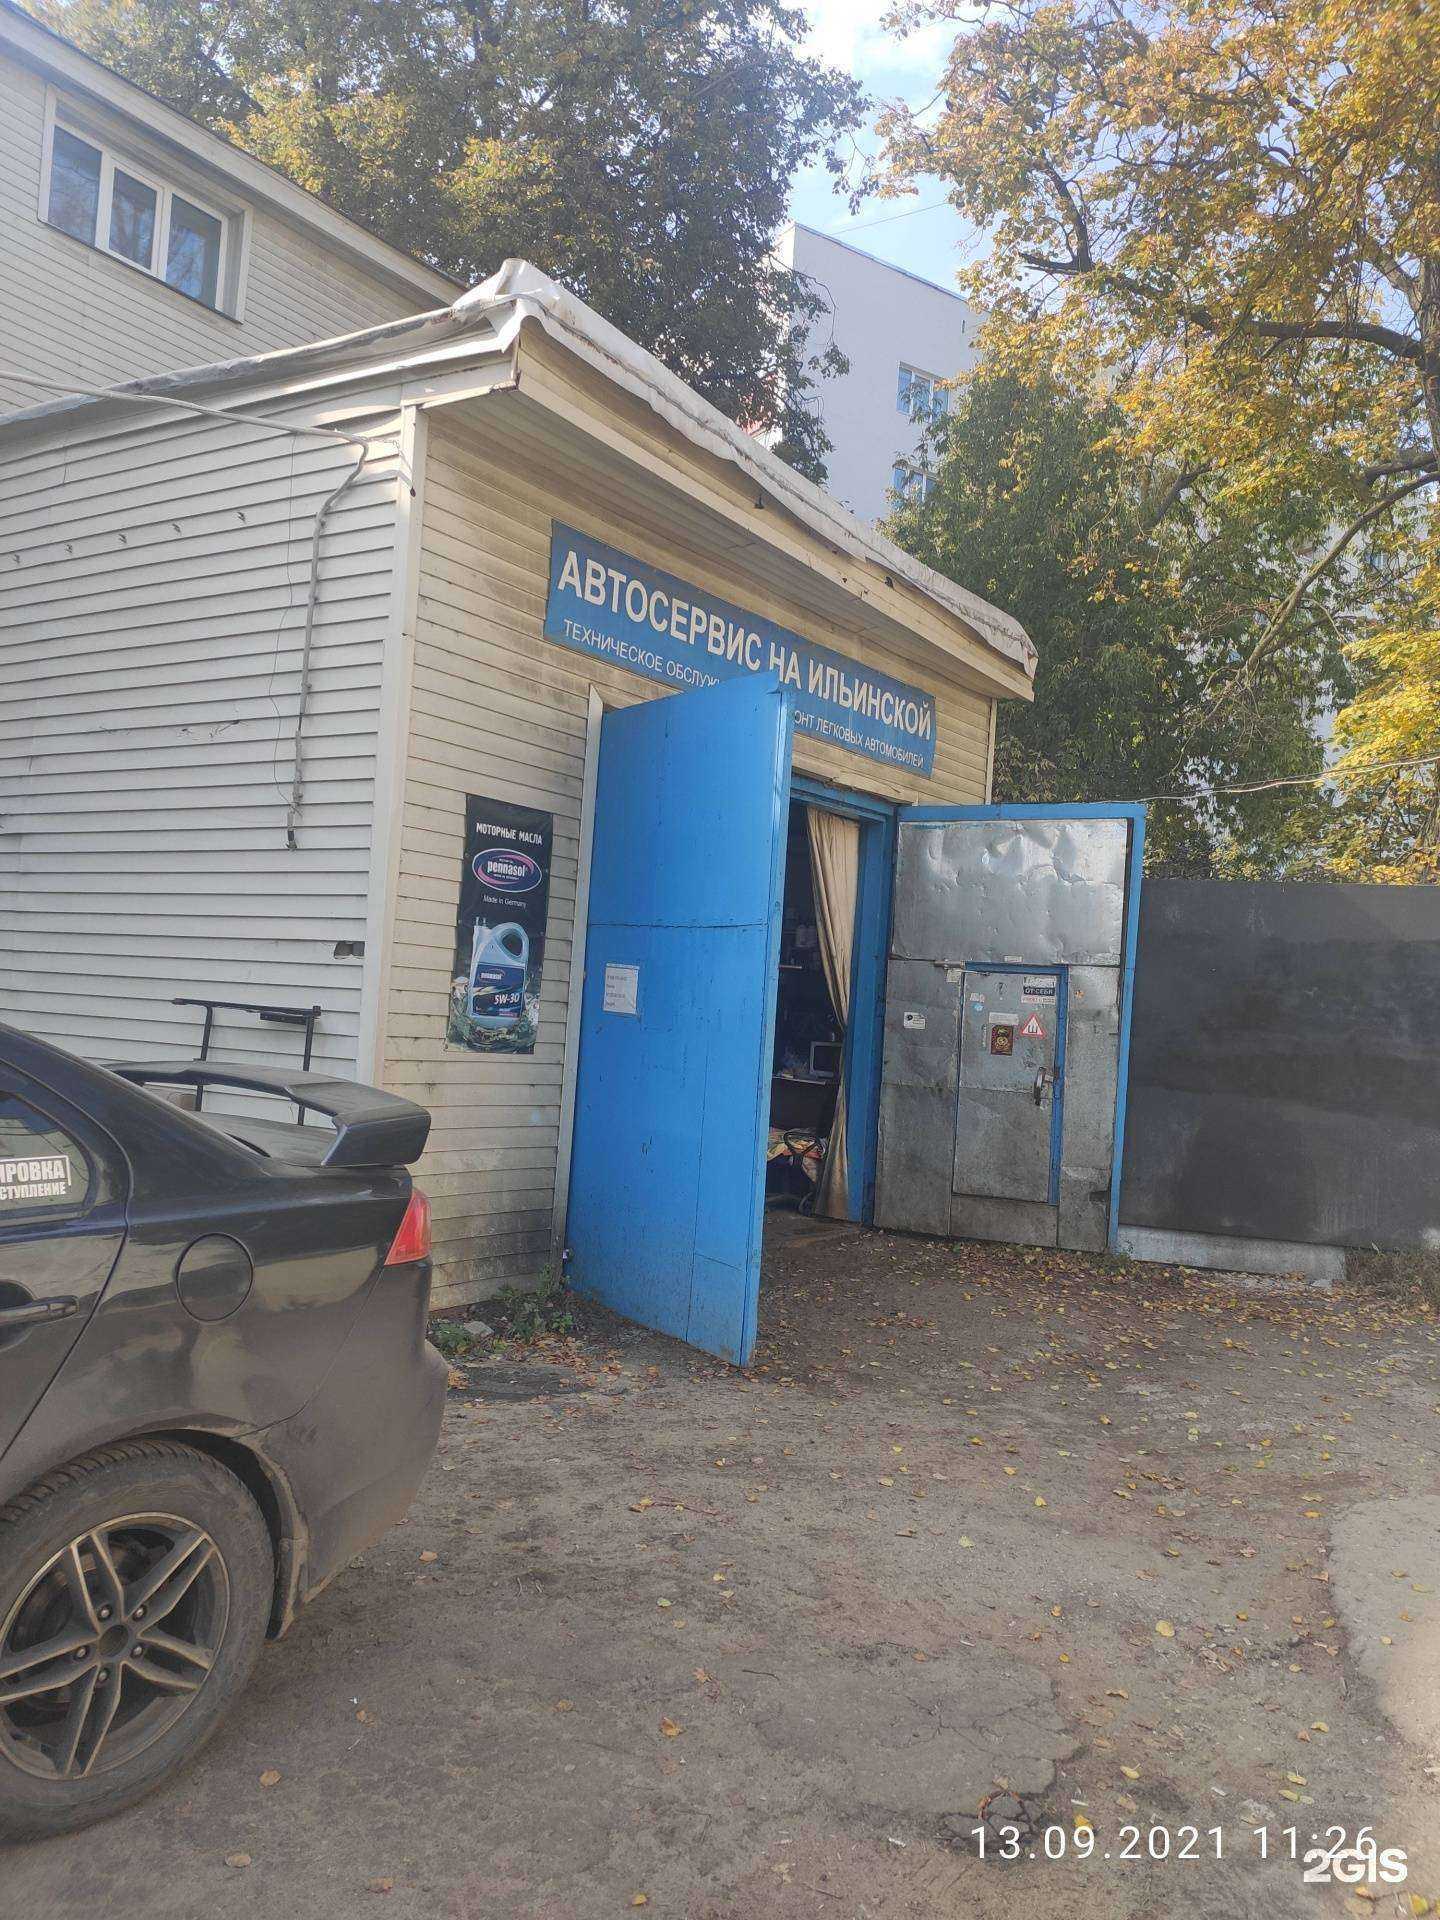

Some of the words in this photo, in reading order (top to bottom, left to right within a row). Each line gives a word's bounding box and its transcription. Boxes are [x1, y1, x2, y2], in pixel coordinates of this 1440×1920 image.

[557, 550, 762, 671] АВТОСЕРВИС
[769, 641, 802, 690] НА
[808, 659, 931, 740] ИЛЬИНСКОЙ
[563, 618, 664, 673] ТЕХНИЧЕСКОЕ
[794, 710, 815, 729] ОНТ
[816, 717, 864, 748] ЛЕГКОВЫХ
[864, 736, 925, 769] АВТОМОБИЛЕЙ
[476, 822, 517, 840] МОТОРНЫЕ
[518, 831, 543, 845] МАСЛА
[487, 860, 526, 878] pennasol
[483, 894, 498, 904] Made
[504, 898, 527, 909] Germany
[494, 992, 520, 1005] 5W-30
